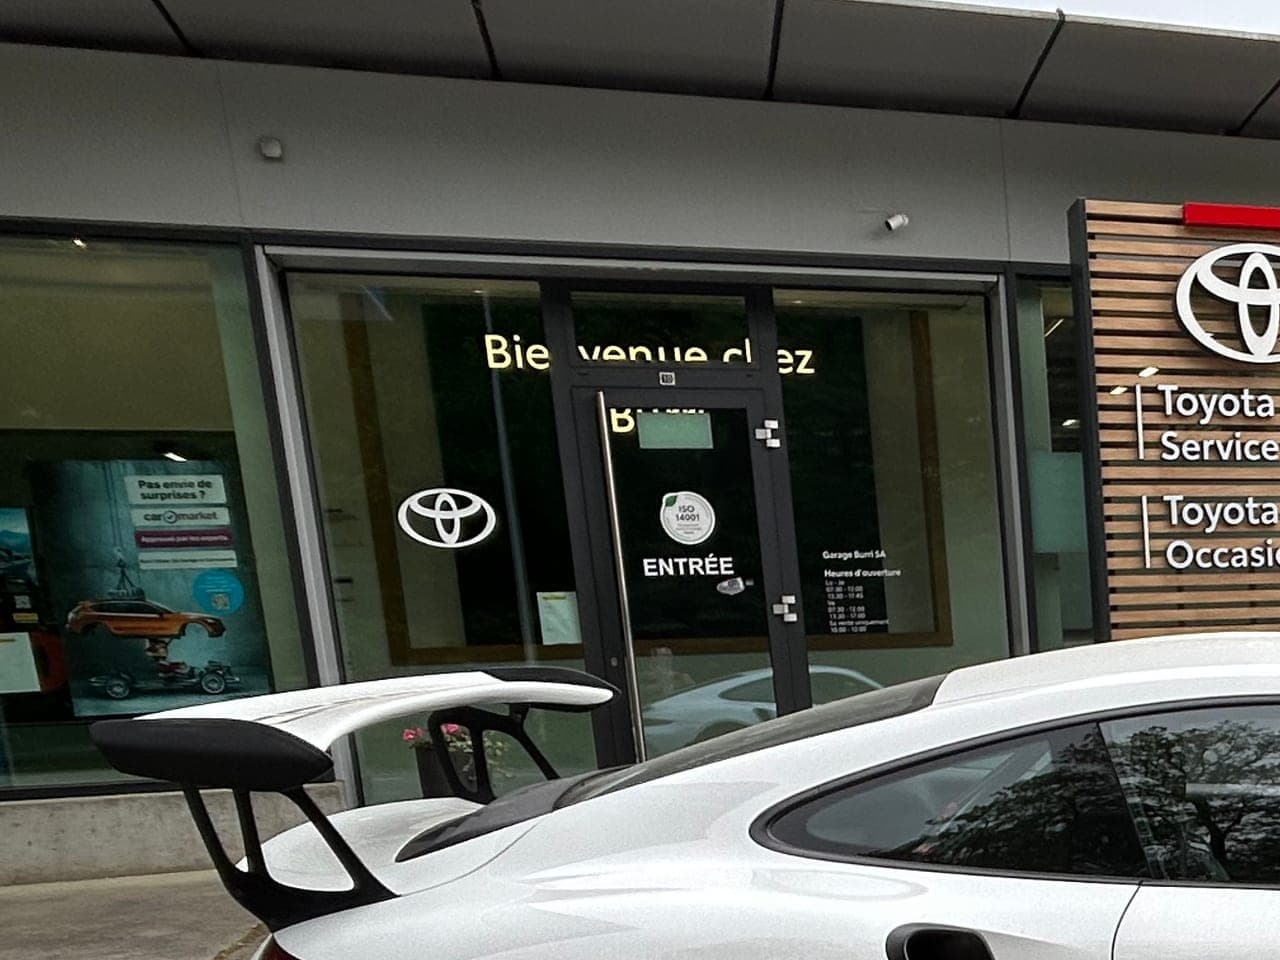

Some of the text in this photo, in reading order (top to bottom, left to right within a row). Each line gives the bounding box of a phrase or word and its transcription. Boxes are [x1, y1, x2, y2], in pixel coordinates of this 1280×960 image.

[1157, 384, 1276, 426] Toyota
[1160, 431, 1280, 461] Service
[138, 480, 213, 489] Pas envie de
[140, 490, 197, 501] surprises
[678, 505, 695, 513] ISO
[1163, 495, 1279, 534] Toyota
[822, 550, 853, 560] Garage
[875, 550, 886, 559] SA
[643, 553, 735, 577] ENTRÉE
[824, 569, 853, 577] Heures
